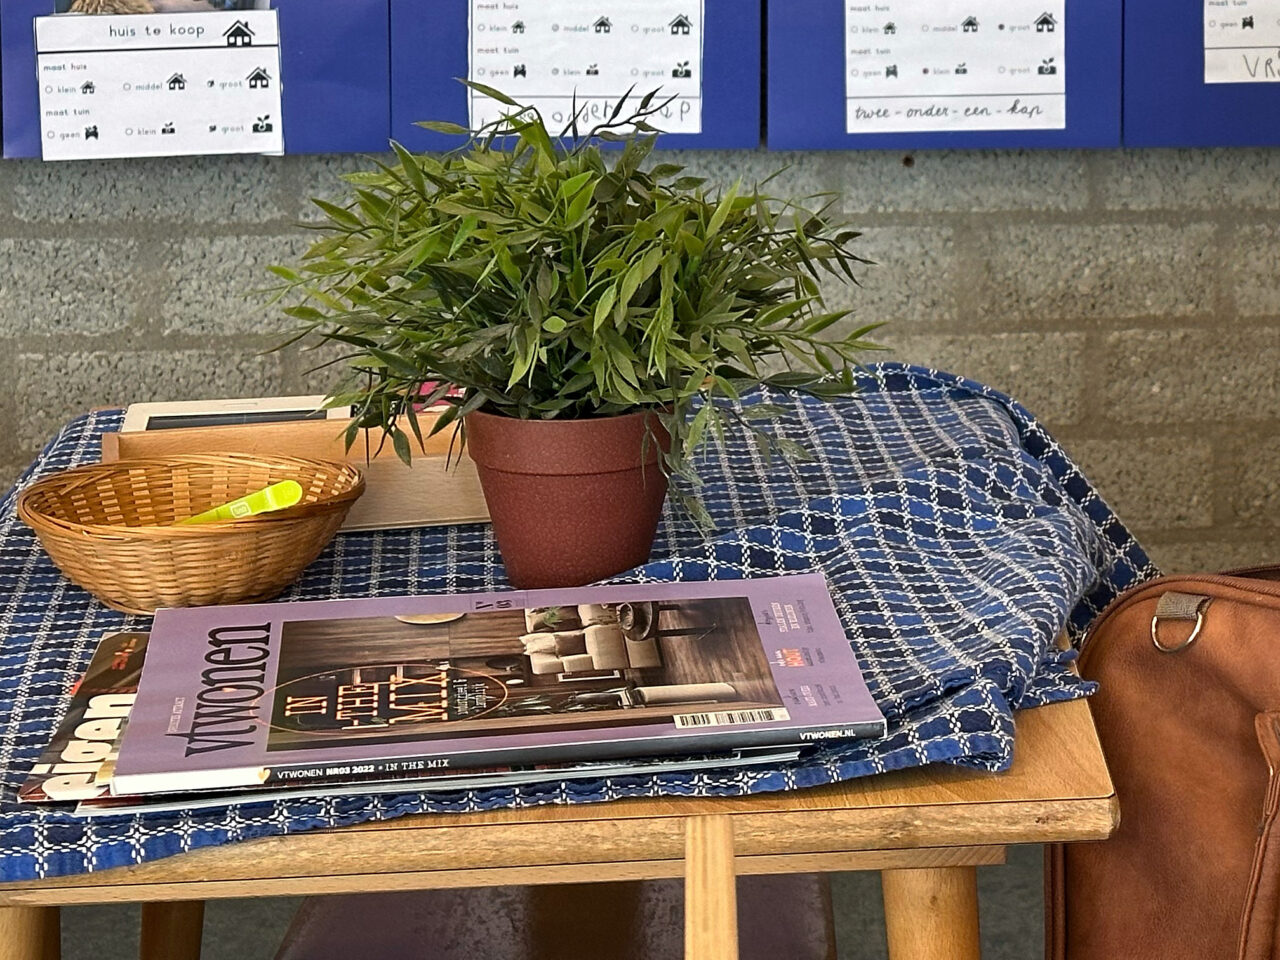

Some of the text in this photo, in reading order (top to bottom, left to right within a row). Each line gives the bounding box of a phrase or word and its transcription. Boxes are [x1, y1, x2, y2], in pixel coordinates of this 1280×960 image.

[109, 23, 205, 39] huis te koop
[57, 80, 243, 94] klein middel groot
[165, 622, 271, 757] vtwonen
[389, 671, 449, 724] MIX
[285, 696, 328, 716] IN
[336, 683, 379, 726] THE
[800, 728, 856, 740] VTWONEN.NL
[29, 693, 138, 800] eigen
[277, 758, 450, 779] VTWONEN NR03 2022 IN THE MIX
